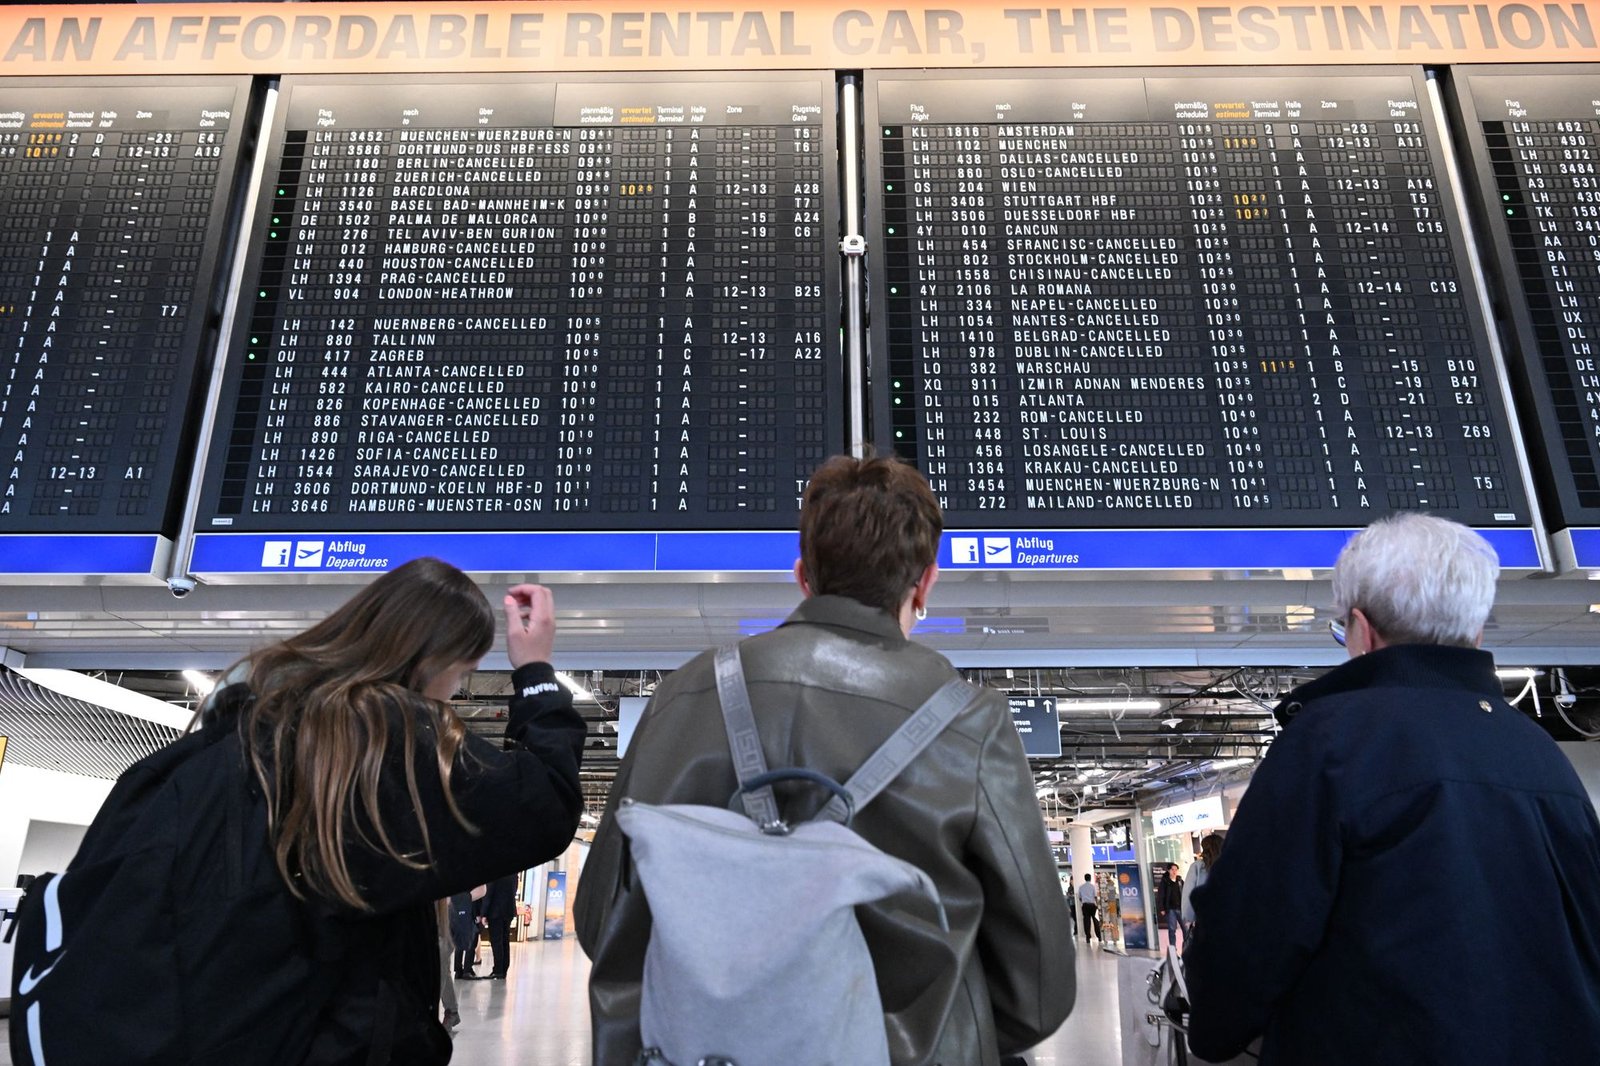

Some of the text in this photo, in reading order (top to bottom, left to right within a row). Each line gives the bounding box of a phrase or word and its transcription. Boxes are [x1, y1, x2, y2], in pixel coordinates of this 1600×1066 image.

[3, 3, 1598, 63] AN AFFORDABLE RENTAL CAR, THE DESTINATION
[911, 104, 923, 112] Flug
[948, 124, 1418, 136] 1816 AMSTERDAM D21
[1558, 122, 1582, 131] 462
[199, 133, 214, 143] E4
[350, 130, 570, 141] 3452 MUENCHEN-WUERZBURG-N
[1561, 136, 1585, 145] 490
[348, 144, 569, 155] 3586 DORTMUND-DUS HBF-ESS
[957, 137, 1421, 150] 102 MUENCHEN A11
[129, 147, 220, 156] 12-13 A19
[356, 158, 533, 168] 180 BERLIN-CANCELLED
[958, 153, 1137, 164] 438 DALLAS-CANCELLED
[345, 172, 540, 182] 1186 ZUERICH-CANCELLED
[958, 167, 1122, 178] 860 OSLO-CANCELLED
[343, 184, 818, 196] 1126 BARCDLONA A28
[959, 179, 1432, 192] 204 WIEN A14
[339, 200, 564, 211] 3540 BASEL BAD-MANNHEIM-K
[951, 196, 1115, 206] 3408 STUTTGART HBF
[339, 212, 819, 225] 1502 PALMA DE MALLORCA A24
[952, 210, 1135, 221] 3506 DUESSELDORF HBF
[343, 228, 554, 239] 276 TEL AVIV-BEN GURION
[962, 222, 1442, 235] 010 CANCUN C15
[341, 243, 534, 254] 012 HAMBURG-CANCELLED
[963, 239, 1175, 250] 454 SFRANCISC-CANCELLED
[339, 258, 533, 269] 440 HOUSTON-CANCELLED
[964, 254, 1177, 265] 802 STOCKHOLM-CANCELLED
[330, 273, 505, 284] 1394 PRAG-CANCELLED
[957, 269, 1170, 280] 1558 CHISINAU-CANCELLED
[334, 286, 820, 299] 904 LONDON-HEATHROW B25
[957, 282, 1456, 295] 2106 LA ROMANA C13
[967, 299, 1156, 310] 334 NEAPEL-CANCELLED
[162, 306, 177, 316] T7
[331, 318, 546, 329] 142 NUERNBERG-CANCELLED
[960, 315, 1158, 326] 1054 NANTES-CANCELLED
[327, 332, 820, 345] 880 TALLINN A16
[961, 330, 1169, 342] 1410 BELGRAD-CANCELLED
[325, 348, 821, 361] 417 ZAGREB A22
[970, 346, 1162, 358] 978 DUBLIN-CANCELLED
[322, 366, 523, 377] 444 ATLANTA-CANCELLED
[971, 360, 1474, 373] 382 WARSCHAU B10
[320, 382, 503, 393] 582 KAIRO-CANCELLED
[972, 376, 1476, 390] 911 IZMIR ADNAN MENDERES B47
[317, 398, 539, 410] 826 KOPENHAGE-CANCELLED
[973, 395, 1084, 406] 015 ATLANTA
[314, 414, 538, 426] 886 STAVANGER-CANCELLED
[974, 411, 1142, 423] 232 ROM-CANCELLED
[312, 431, 489, 443] 890 RIGA-CANCELLED
[976, 426, 1490, 439] 448 ST. LOUIS Z69
[302, 448, 497, 460] 1426 SOFIA-CANCELLED
[976, 444, 1204, 456] 456 LOSANGELE-CANCELLED
[125, 467, 142, 478] A1
[299, 465, 524, 477] 1544 SARAJEVO-CANCELLED
[969, 461, 1177, 473] 1364 KRAKAU-CANCELLED
[294, 482, 542, 494] 3606 DORTMUND-KOELN HBF-D
[969, 478, 1219, 491] 3454 MUENCHEN-WUERZBURG-N
[292, 499, 541, 512] 3646 HAMBURG-MUENSTER-OSN
[979, 496, 1191, 508] 272 MAILAND-CANCELLED
[328, 542, 366, 555] Abflug
[1016, 538, 1053, 551] Abflug
[325, 556, 388, 569] Departures
[1017, 552, 1079, 565] Departures
